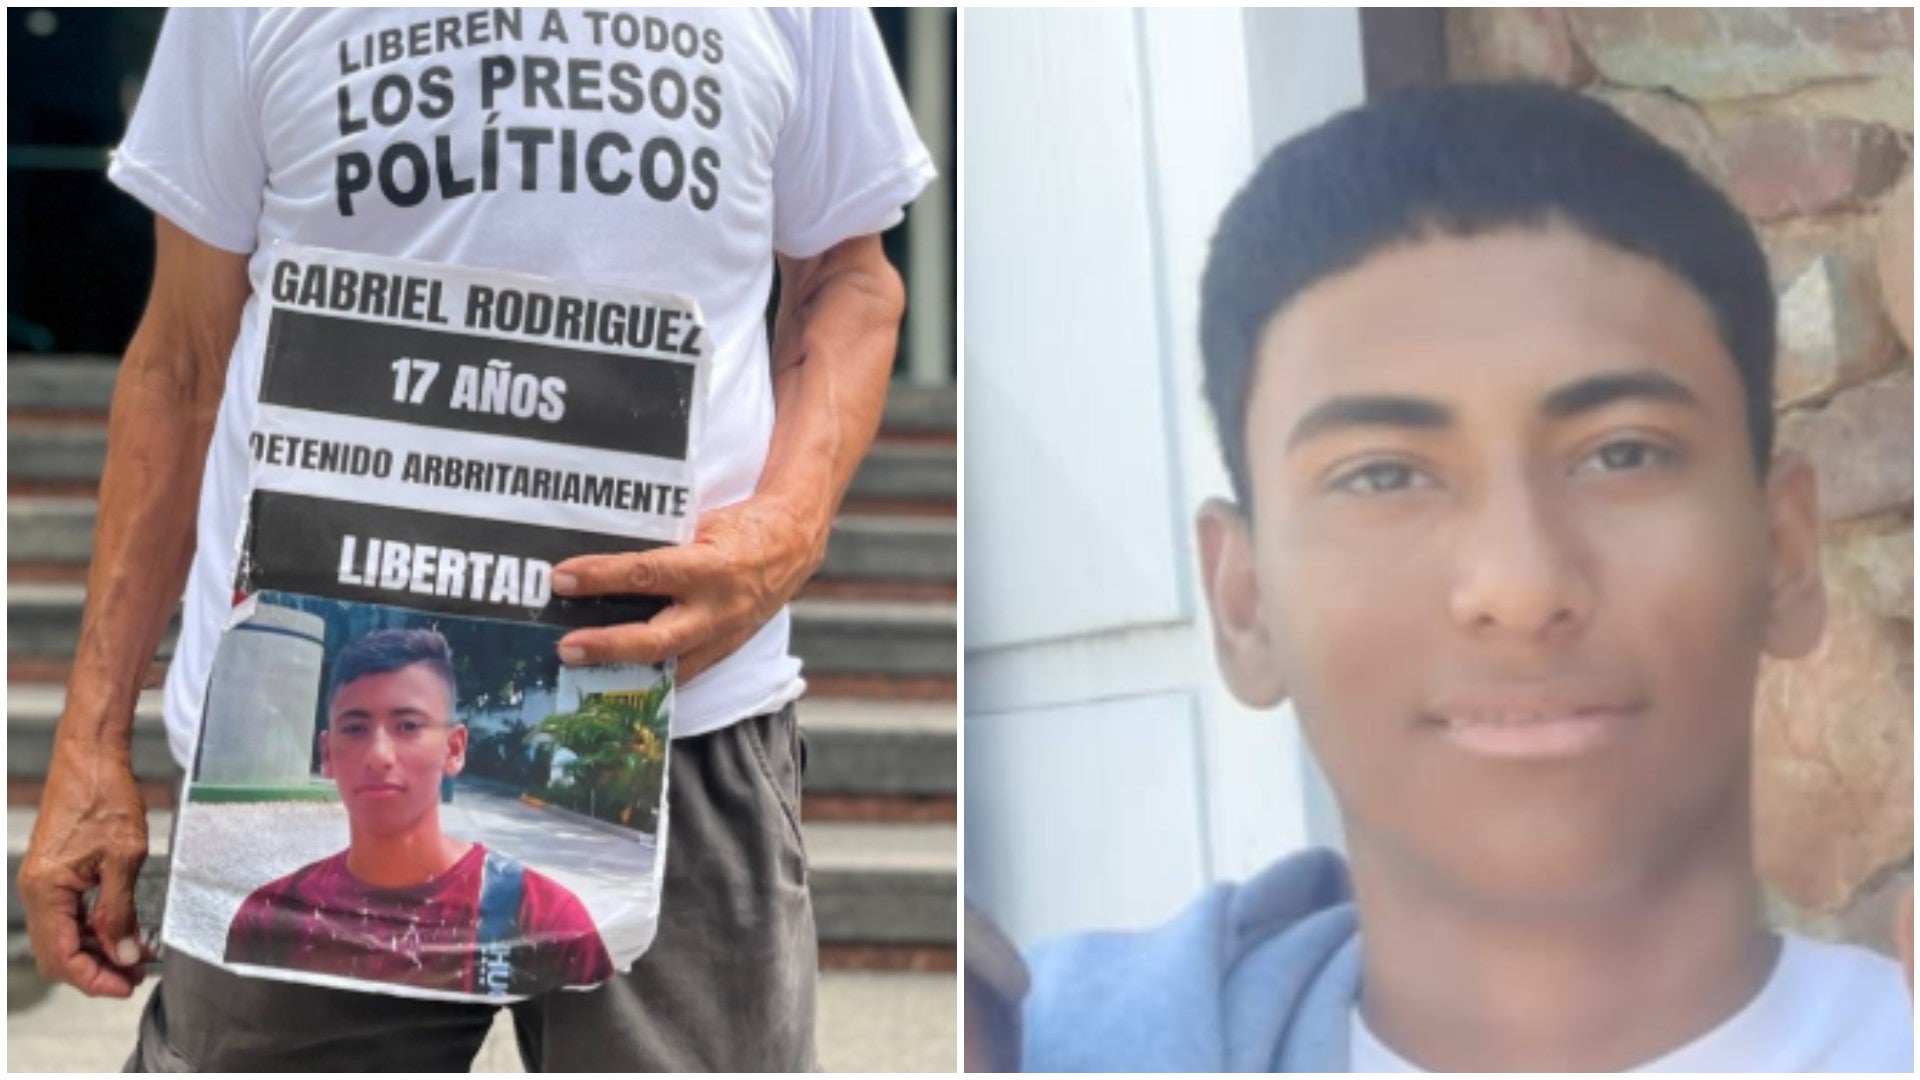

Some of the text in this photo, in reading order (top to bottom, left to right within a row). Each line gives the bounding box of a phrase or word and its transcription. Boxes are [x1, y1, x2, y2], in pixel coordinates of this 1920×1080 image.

[338, 8, 724, 76] LIBEREN A TODOS
[337, 55, 722, 137] LOS PRESOS
[336, 112, 721, 217] POLÍTICOS
[271, 259, 702, 355] GABRIEL RODRIGUEZ
[390, 358, 567, 423] 17 AÑOS
[401, 452, 689, 517] ARBRITARIAMENTE
[337, 534, 552, 608] LIBERTAD
